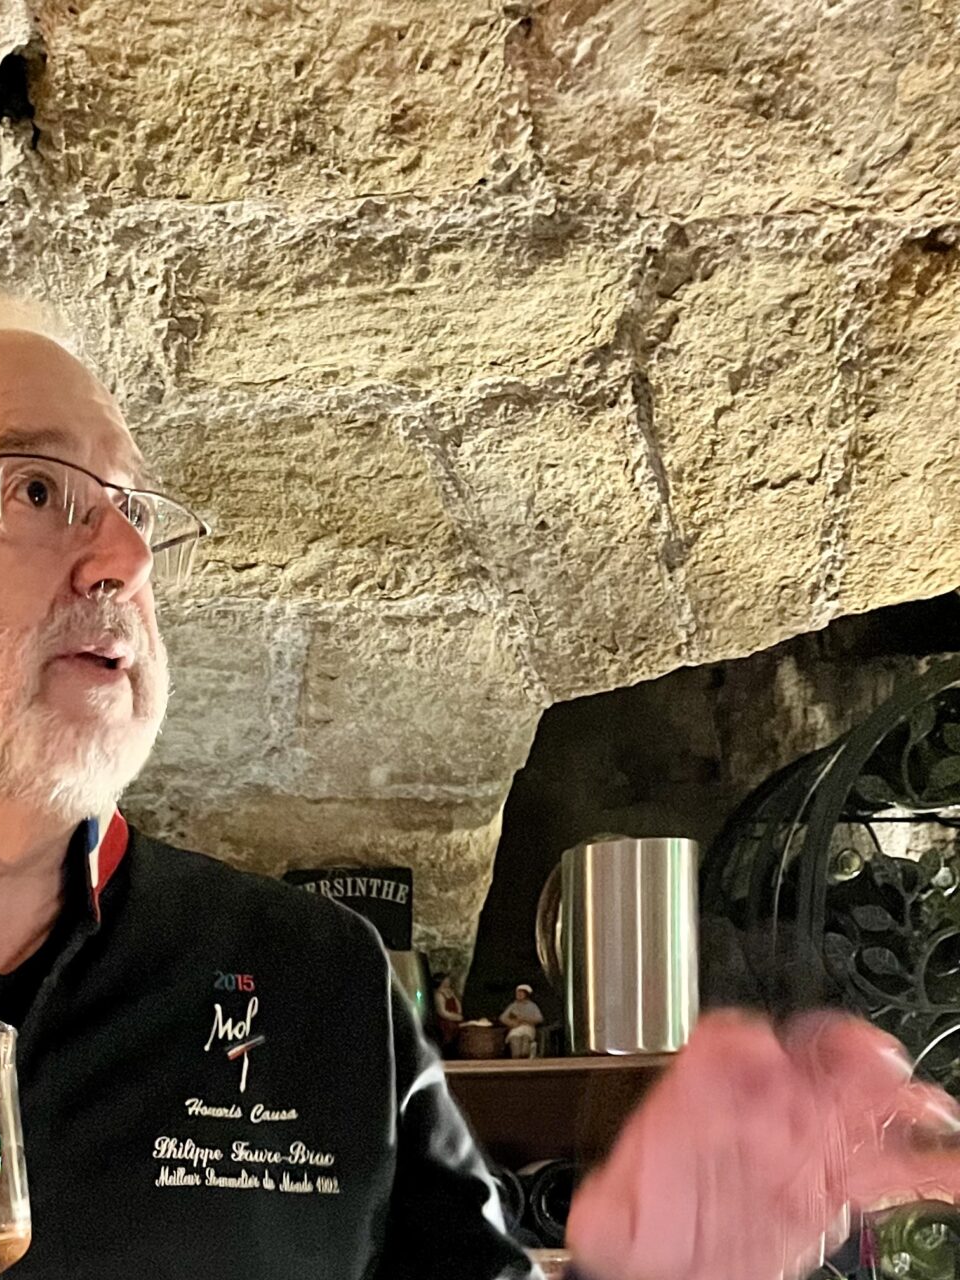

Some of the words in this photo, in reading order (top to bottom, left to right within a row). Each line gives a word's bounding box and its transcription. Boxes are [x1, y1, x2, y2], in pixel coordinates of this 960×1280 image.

[298, 877, 409, 904] ERSINTHE
[214, 971, 256, 992] 2015
[250, 1104, 298, 1124] Causa
[152, 1136, 224, 1168] Philippe
